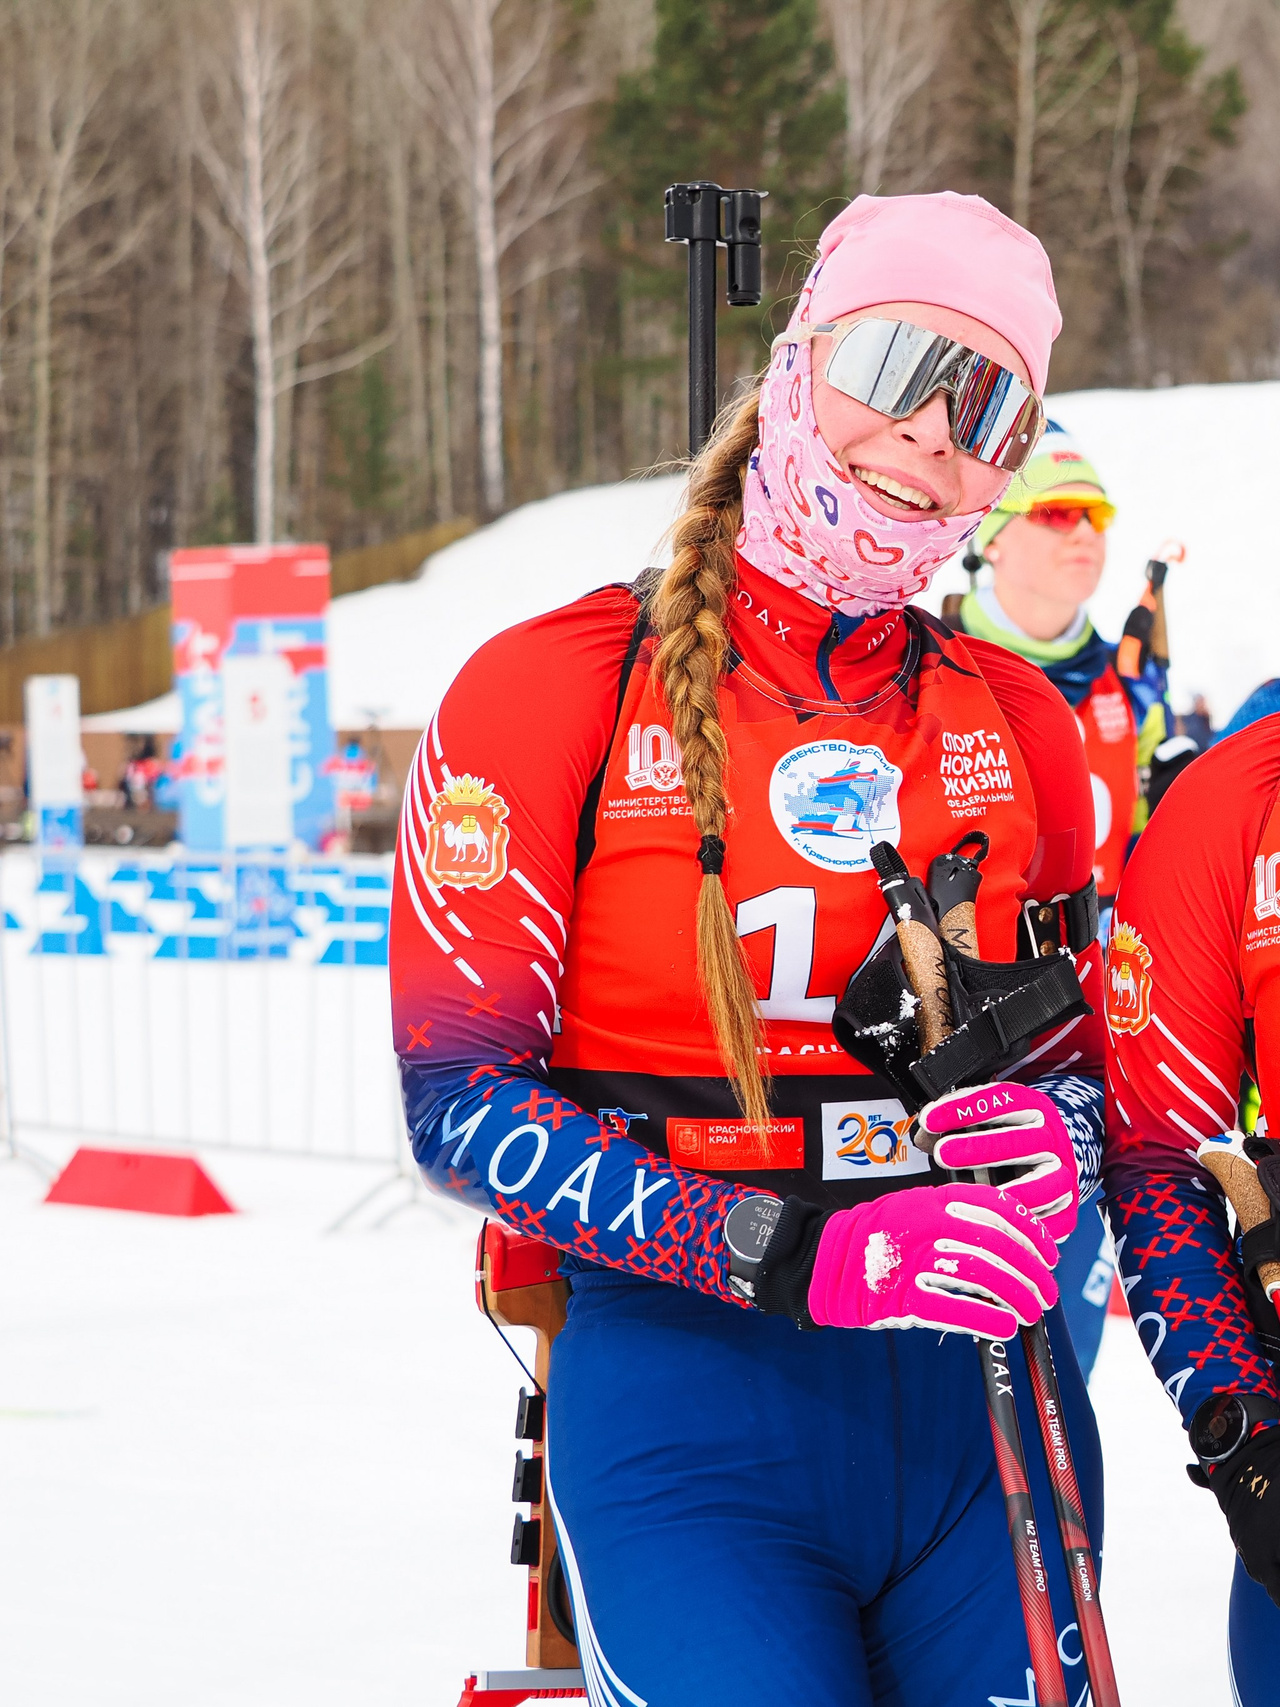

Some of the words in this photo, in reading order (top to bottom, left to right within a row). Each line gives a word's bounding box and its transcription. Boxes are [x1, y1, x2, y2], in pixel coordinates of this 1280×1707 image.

[737, 590, 792, 641] OAX
[628, 723, 683, 775] 10
[778, 743, 847, 775] ПЕРВЕНСТВО
[849, 747, 896, 774] РОССИИ
[940, 748, 1009, 776] НОРМА
[941, 769, 1013, 797] ЖИЗНИ
[608, 795, 688, 808] МИНИСТЕРСТВО
[947, 791, 1015, 808] ФЕДЕРАЛЬНЫЙ
[951, 806, 987, 818] ПРОЕКТ
[603, 806, 667, 820] РОССИЙСКОЙ
[802, 843, 868, 867] Красноярск
[956, 1090, 1014, 1121] MOAX
[708, 1134, 737, 1144] КРАЙ
[426, 1100, 671, 1239] MOAX
[989, 1341, 1014, 1397] OAX
[1045, 1399, 1057, 1415] M2
[1049, 1416, 1063, 1447] TEAM
[1055, 1447, 1068, 1470] PRO
[1025, 1519, 1036, 1536] M2
[1029, 1537, 1043, 1569] TEAM
[1076, 1553, 1086, 1566] HM
[1034, 1569, 1046, 1593] PRO
[1079, 1566, 1093, 1602] CARBON
